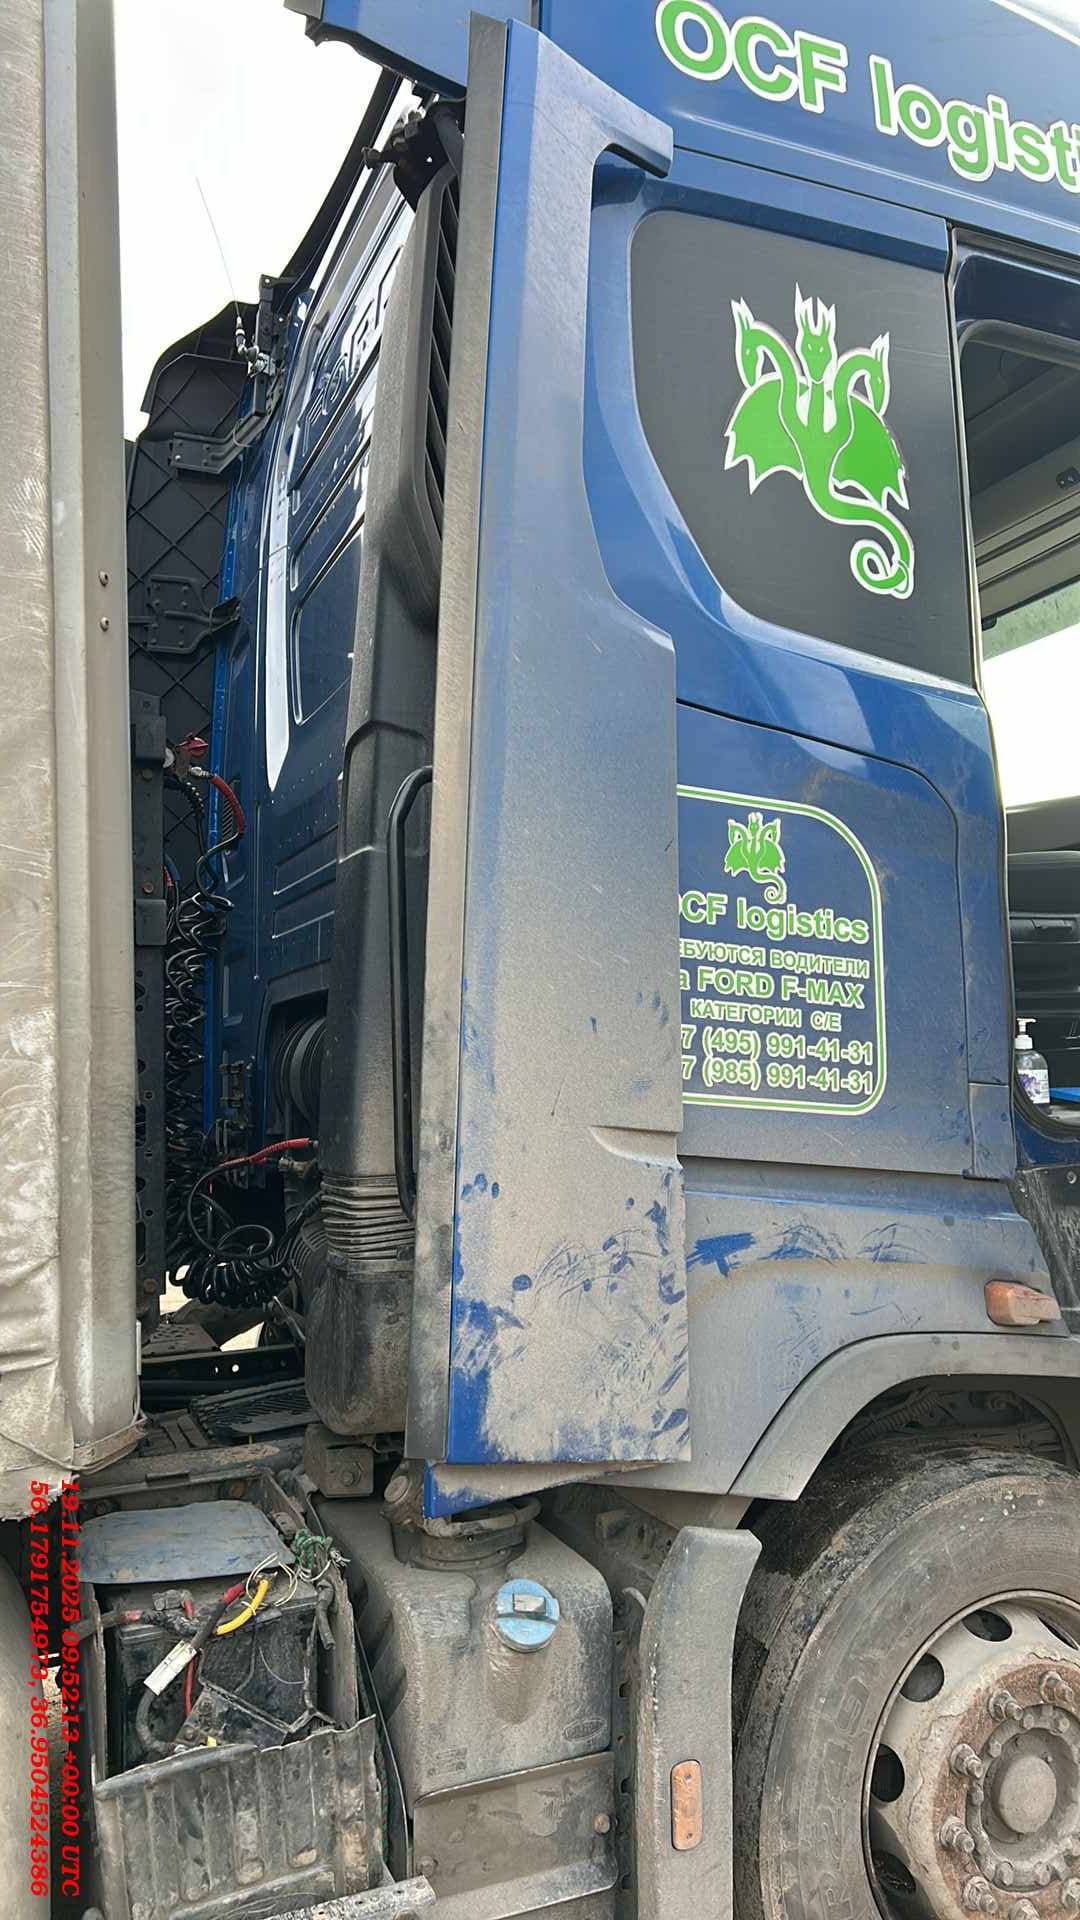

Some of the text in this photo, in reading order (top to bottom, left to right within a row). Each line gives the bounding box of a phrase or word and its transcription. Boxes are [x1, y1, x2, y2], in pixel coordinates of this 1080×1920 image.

[655, 0, 849, 113] OCF
[679, 891, 868, 943] CF logistics
[771, 949, 869, 978] ВОДИТЕЛИ
[698, 966, 774, 997] FORD
[782, 976, 863, 1008] F-MAX
[691, 999, 801, 1027] КАТЕГОРИИ
[702, 1026, 762, 1060] (495)
[766, 1031, 873, 1065] 991-41-31
[702, 1057, 762, 1090] (985)
[767, 1063, 872, 1093] 991-41-31
